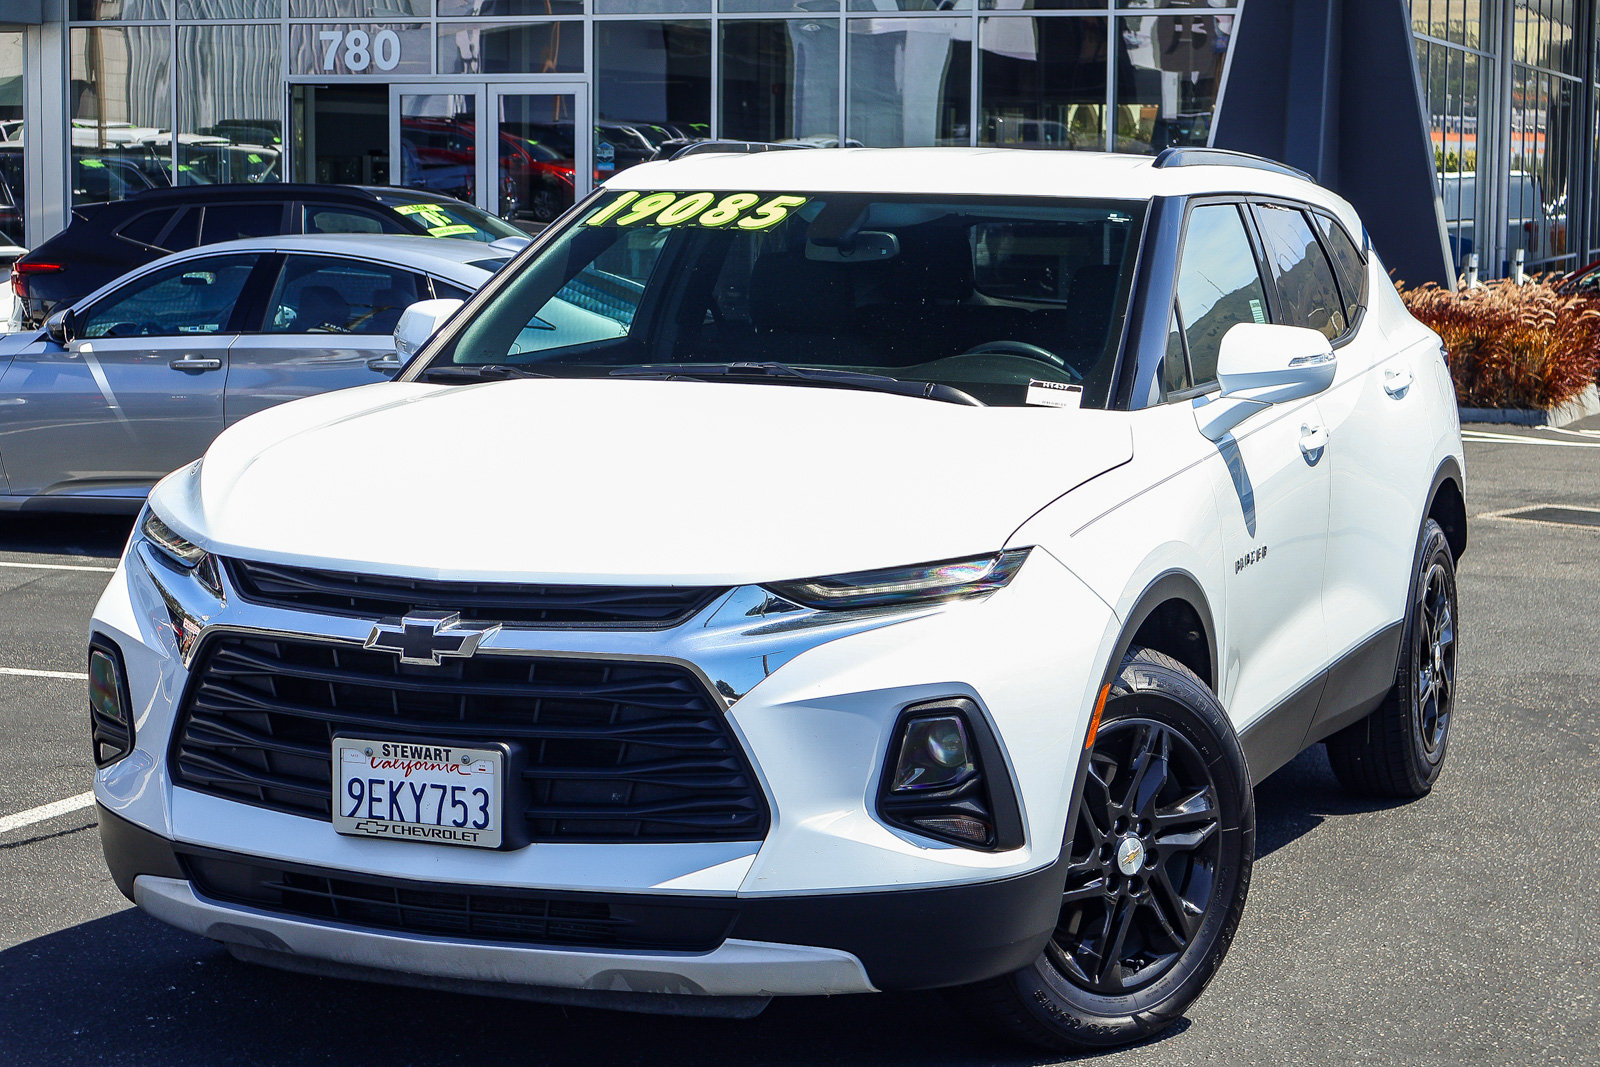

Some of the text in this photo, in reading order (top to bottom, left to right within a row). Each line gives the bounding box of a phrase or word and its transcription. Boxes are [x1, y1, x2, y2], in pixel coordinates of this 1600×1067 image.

[319, 29, 401, 71] 780
[585, 191, 807, 230] 19085
[370, 756, 472, 778] California
[382, 743, 452, 763] STEWART
[347, 777, 490, 830] 9EKY753
[392, 824, 480, 843] CHEVROLET
